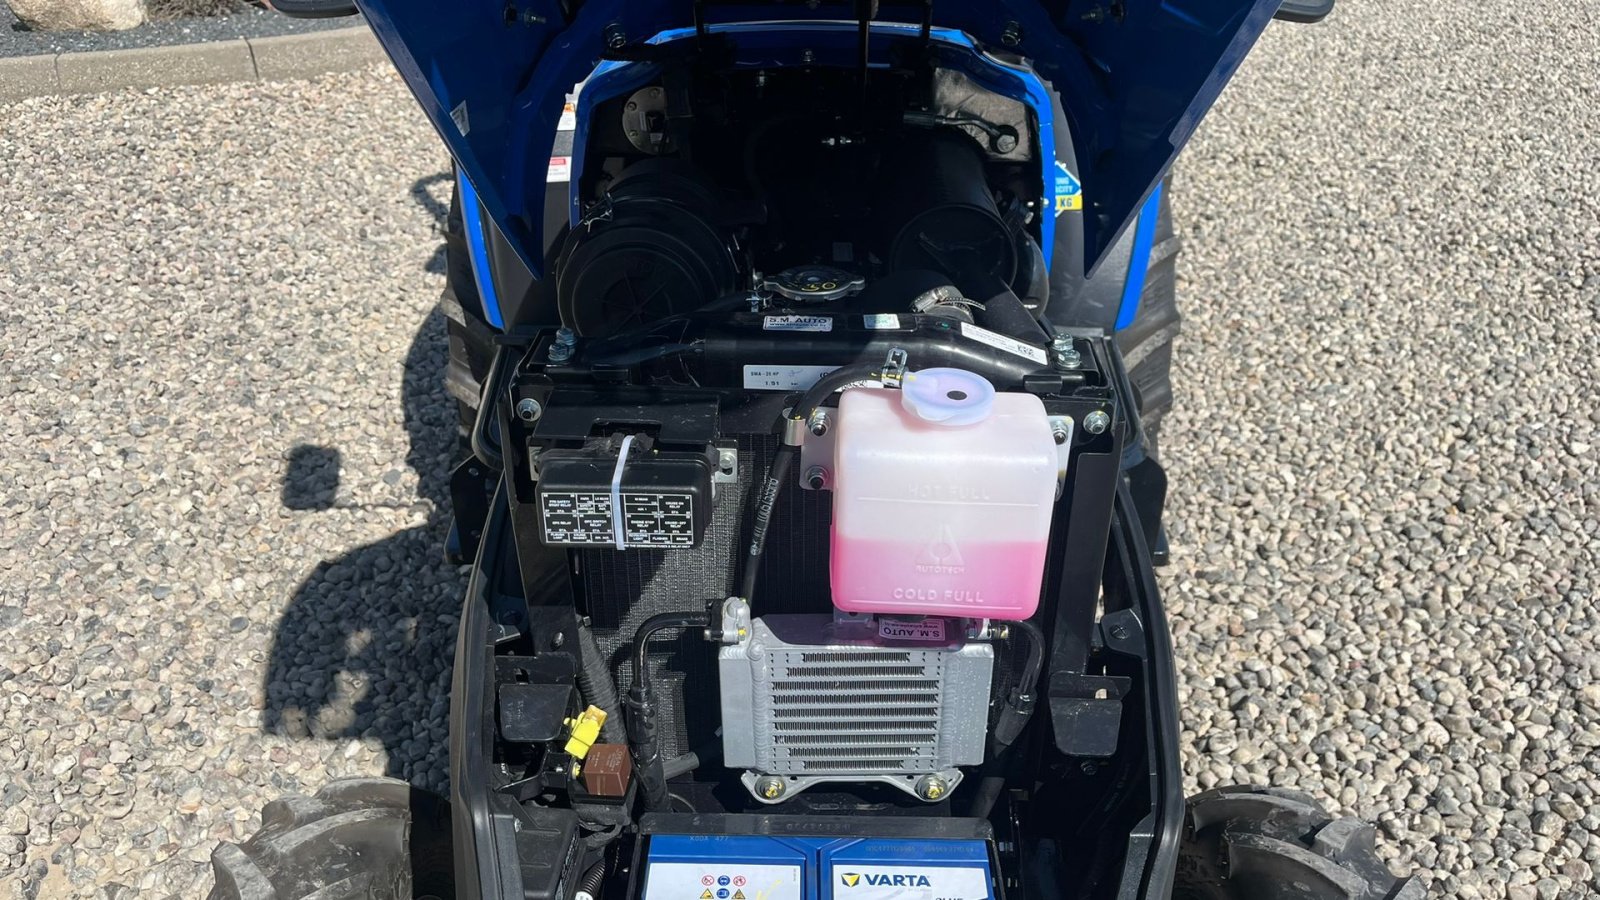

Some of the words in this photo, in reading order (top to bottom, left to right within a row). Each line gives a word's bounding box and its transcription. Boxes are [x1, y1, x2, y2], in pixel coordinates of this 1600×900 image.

[1060, 197, 1072, 208] KG
[908, 483, 941, 498] HOT
[950, 485, 991, 500] FULL
[893, 587, 938, 601] COLD
[943, 590, 984, 603] FULL
[883, 626, 914, 637] AUTO
[914, 628, 940, 638] S.M.
[864, 873, 931, 887] VARTA
